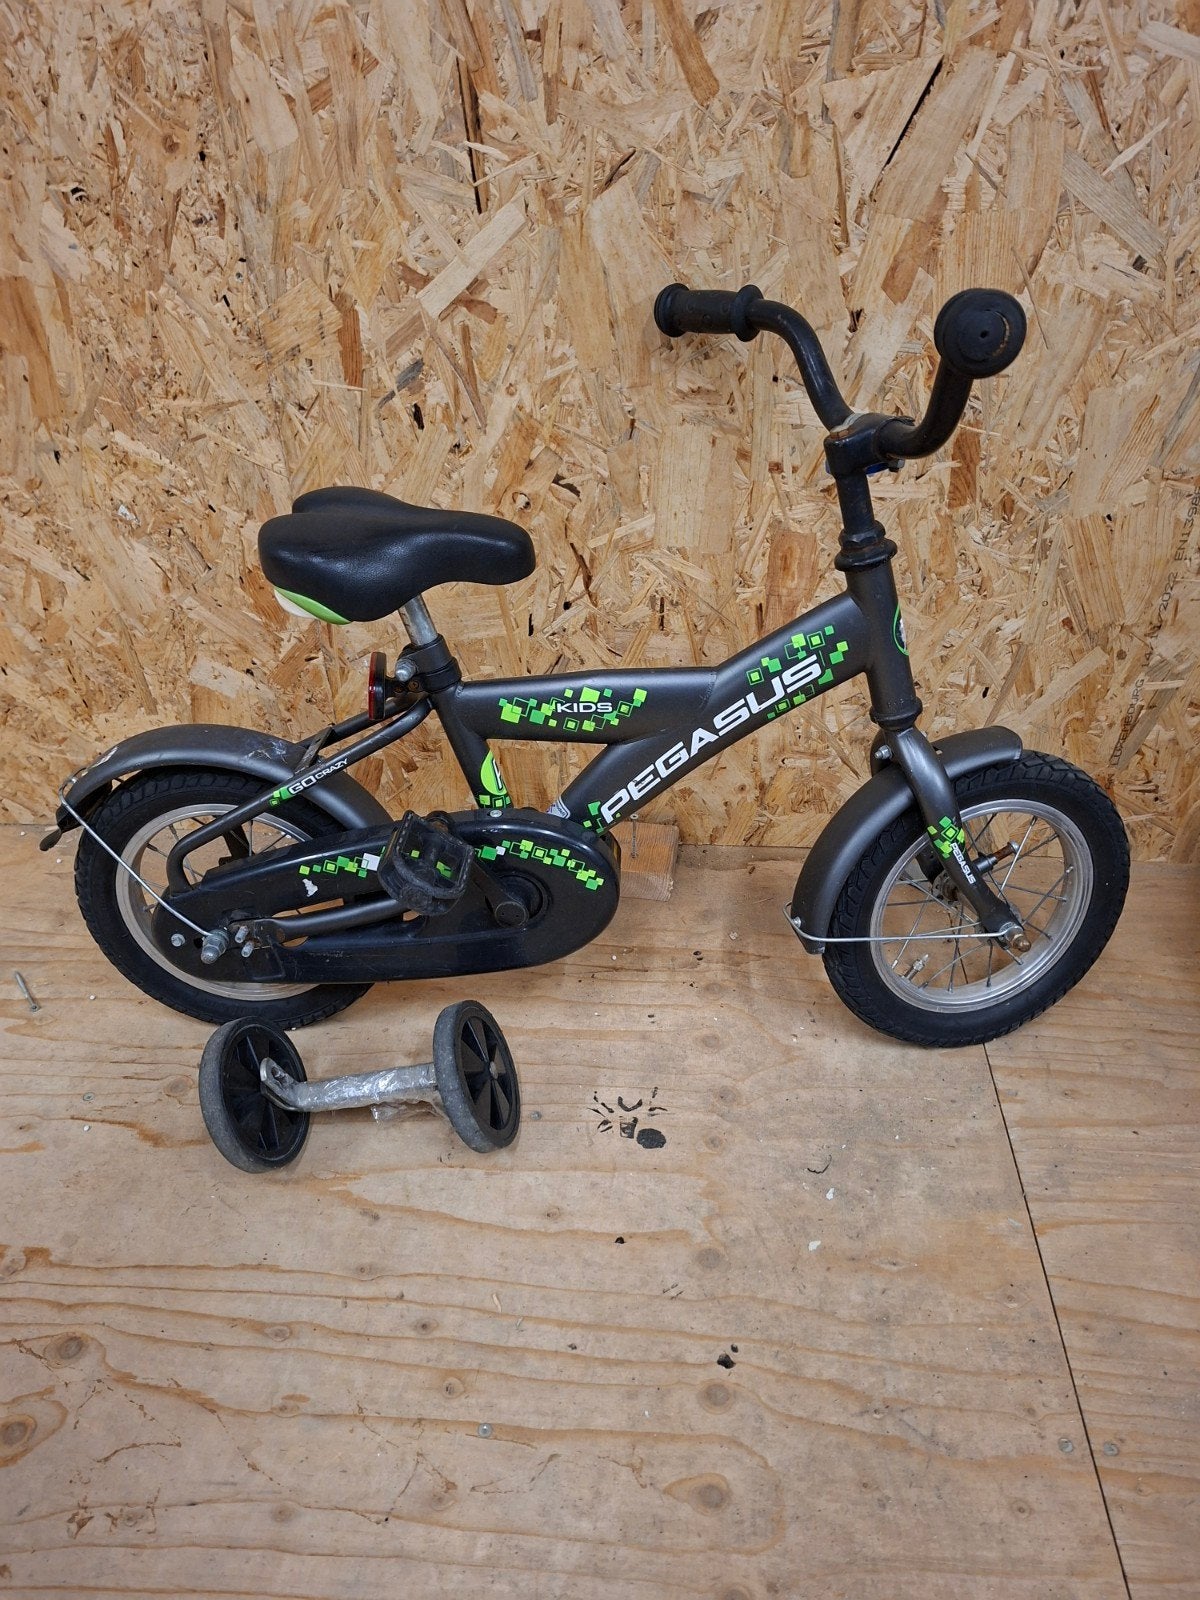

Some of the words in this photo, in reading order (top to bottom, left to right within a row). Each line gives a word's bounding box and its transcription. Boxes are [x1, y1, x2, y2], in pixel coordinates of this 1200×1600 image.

[556, 702, 613, 713] KIDS
[600, 654, 822, 824] PEGASUS
[288, 775, 317, 795] GO
[314, 757, 348, 780] CRAZY
